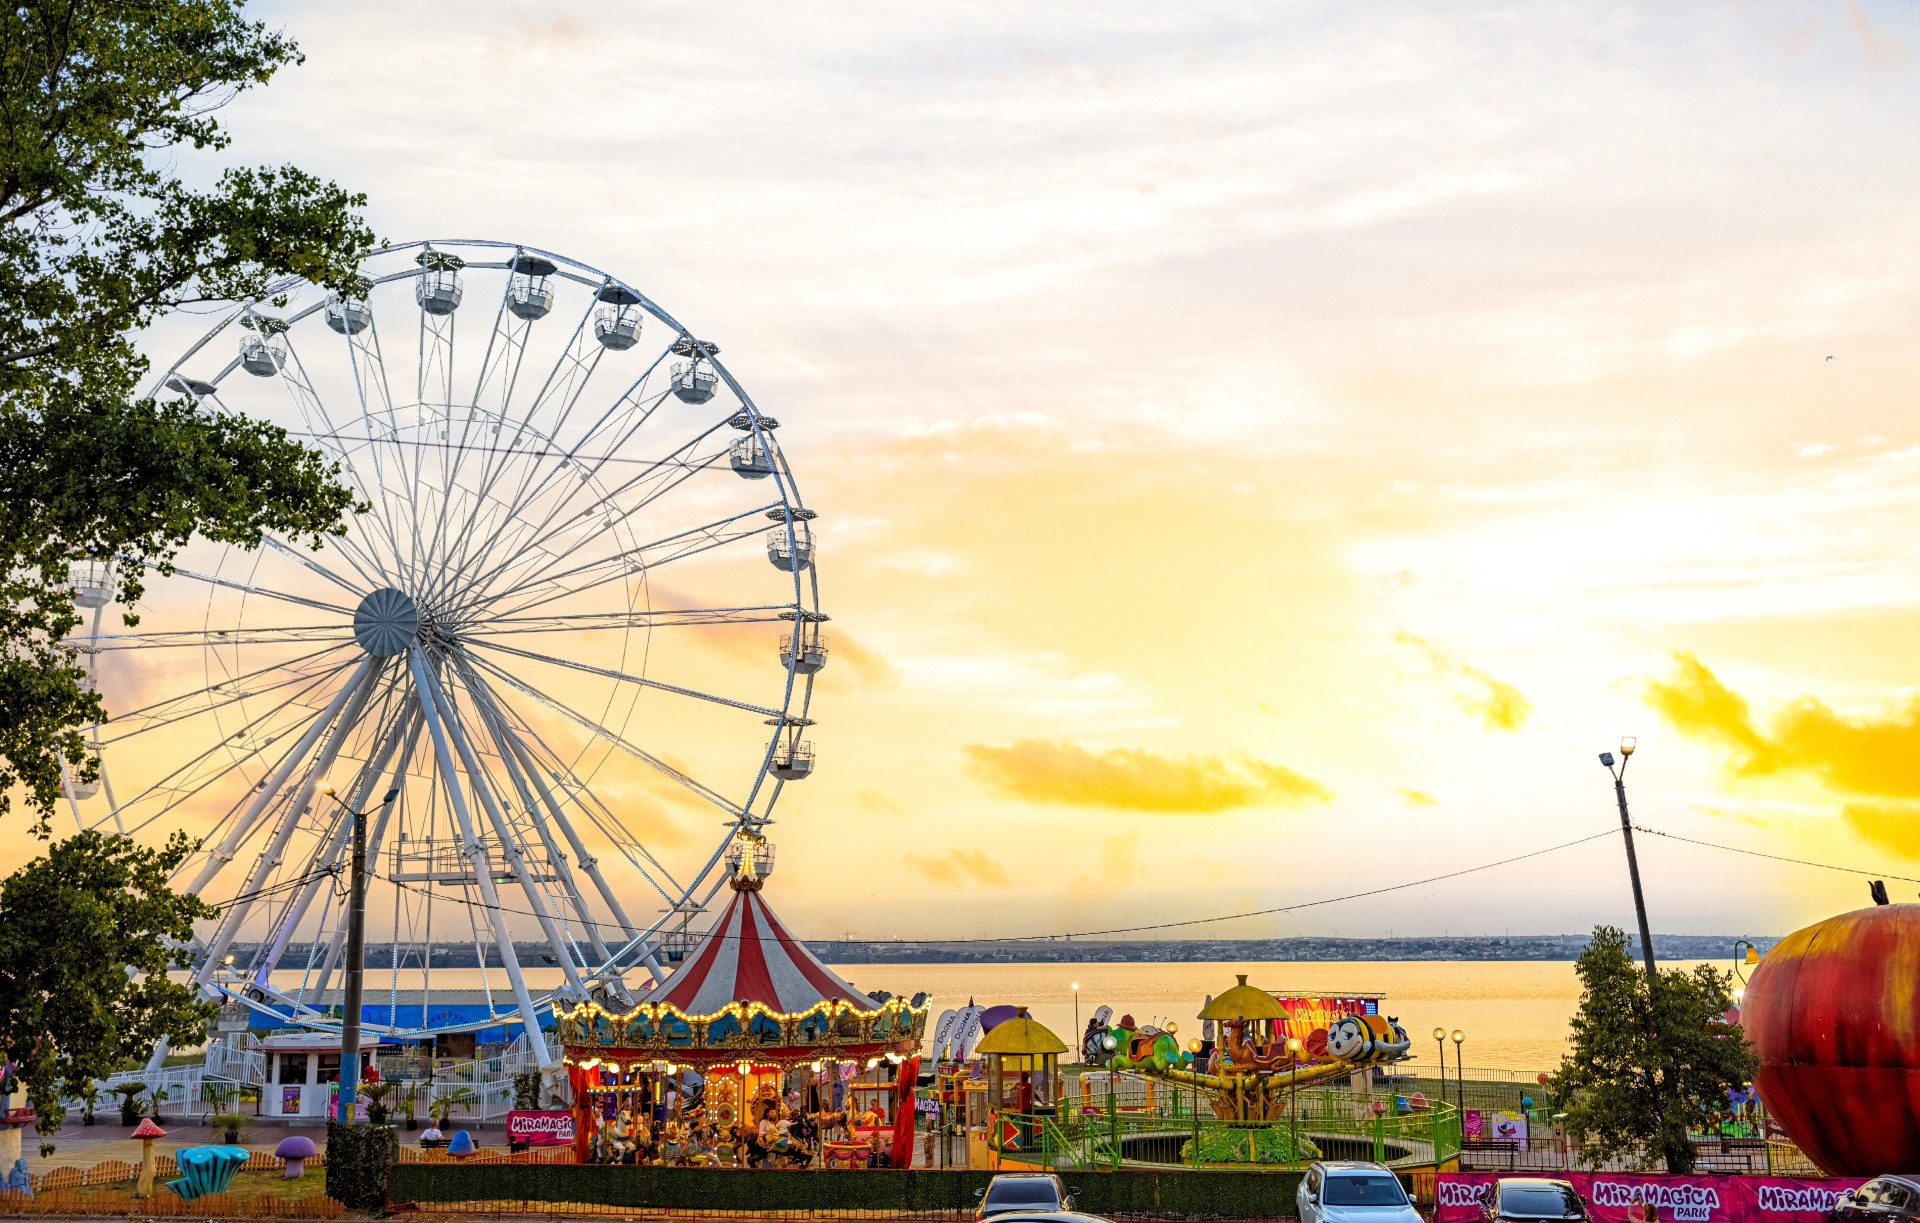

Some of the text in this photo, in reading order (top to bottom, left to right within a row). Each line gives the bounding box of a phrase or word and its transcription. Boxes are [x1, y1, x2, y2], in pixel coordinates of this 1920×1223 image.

[937, 1015, 957, 1044] DORNA
[954, 1012, 972, 1040] DORNA
[558, 1130, 573, 1138] PAR
[1676, 1207, 1708, 1218] PARK
